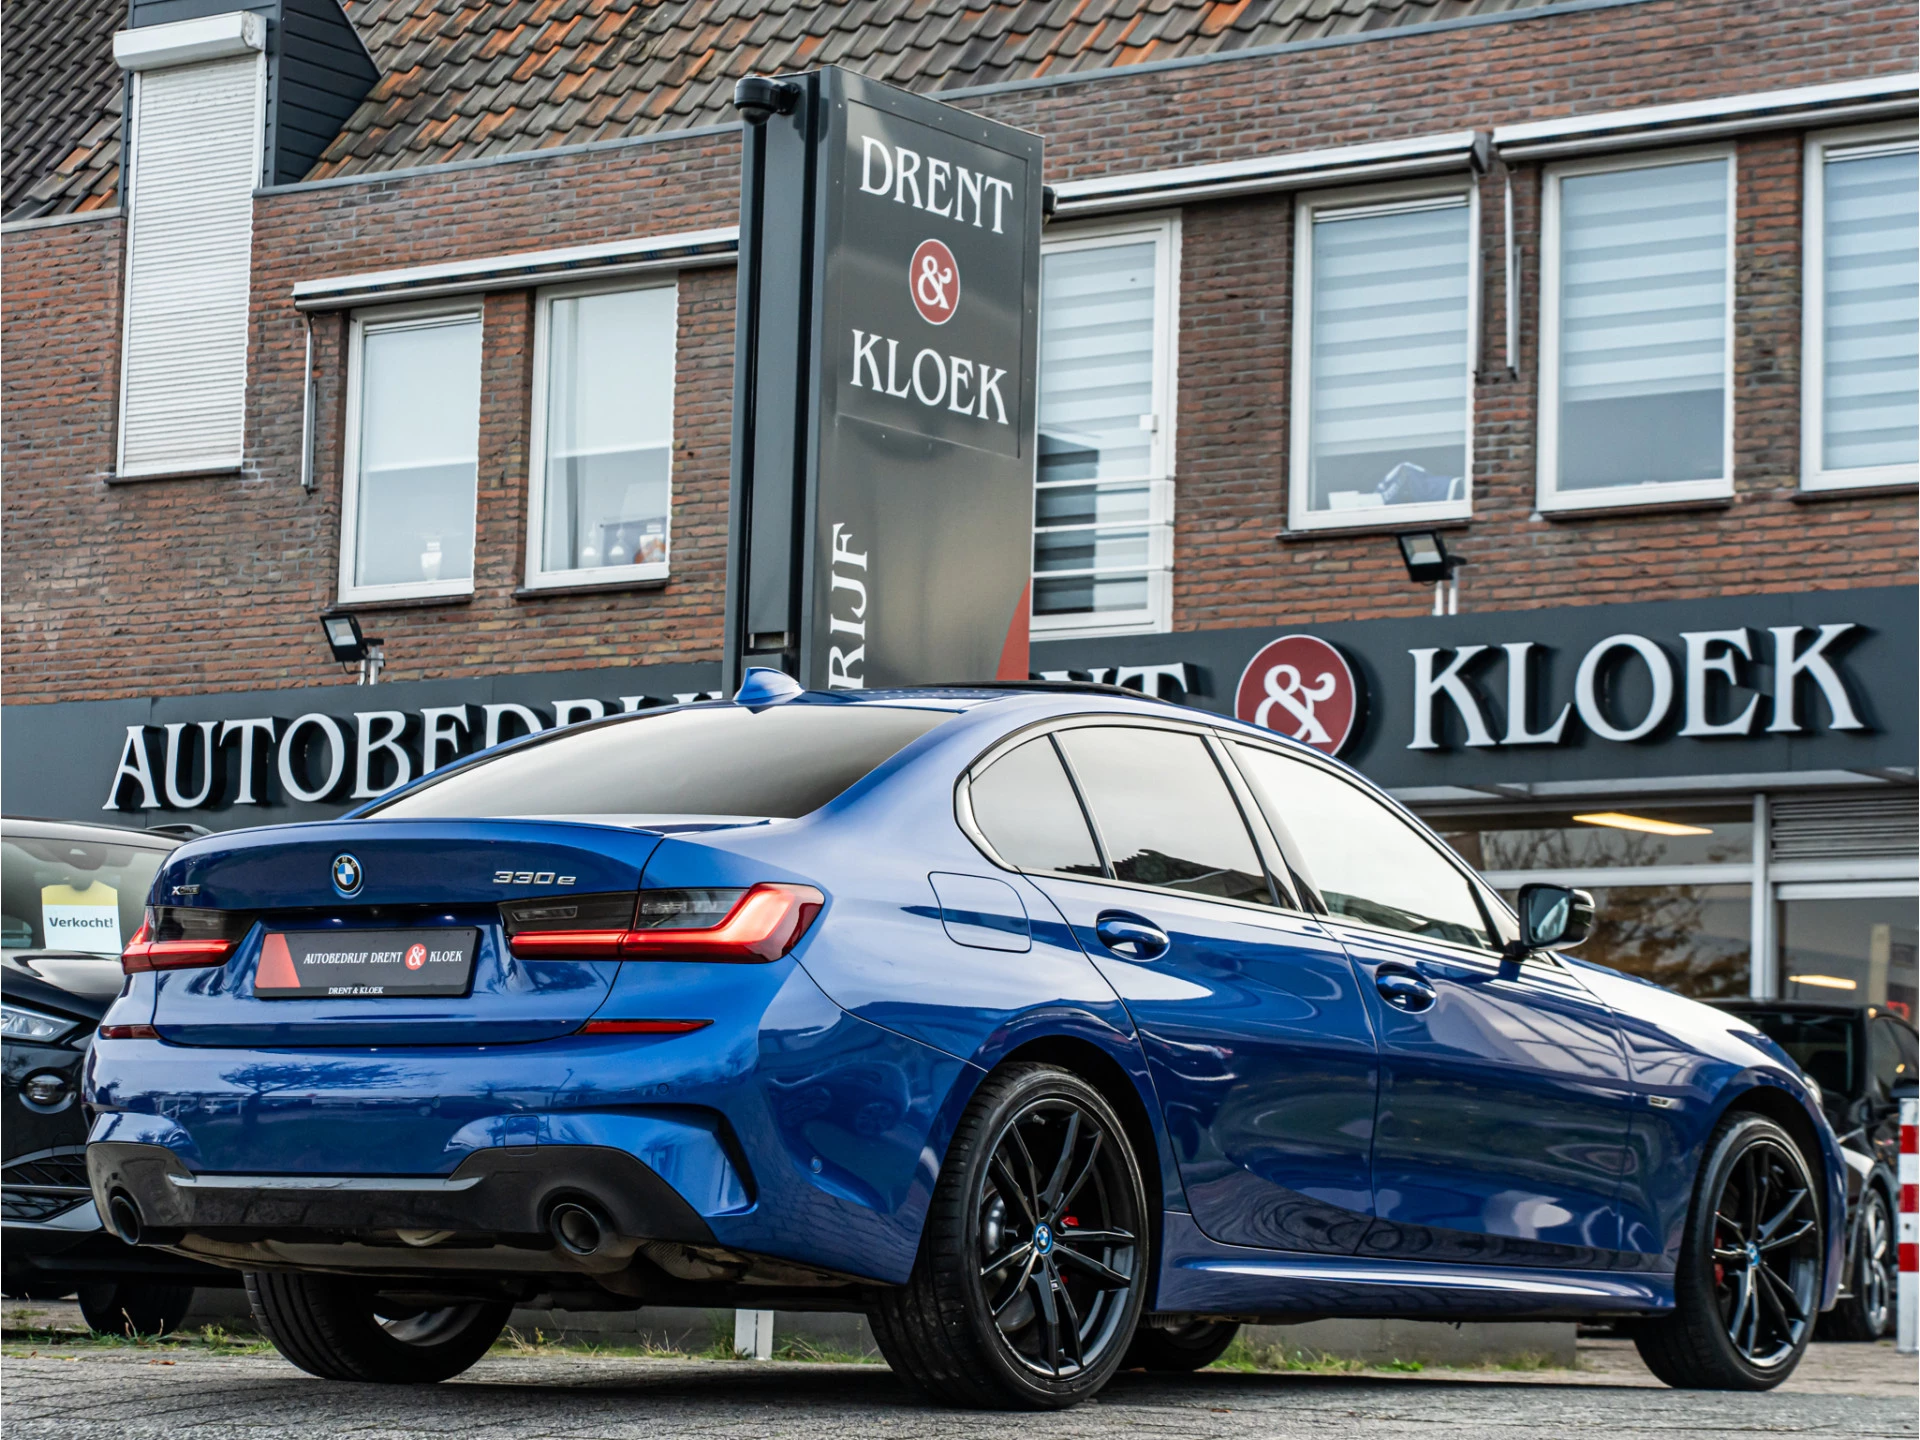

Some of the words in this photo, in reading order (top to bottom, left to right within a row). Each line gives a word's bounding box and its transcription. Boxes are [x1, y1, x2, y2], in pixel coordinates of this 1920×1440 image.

[859, 135, 1014, 234] DRENT
[917, 255, 952, 310] &
[850, 328, 1010, 425] KLOEK
[1254, 663, 1337, 744] &
[1407, 623, 1865, 749] KLOEK
[493, 870, 577, 885] 330e
[48, 917, 114, 928] Verkocht!
[303, 952, 368, 965] AUTOBEDRIJF
[370, 951, 403, 963] DRENT
[408, 945, 425, 966] &
[429, 950, 463, 963] KLOEK
[328, 986, 352, 995] DRENT
[359, 986, 384, 994] KLOEK
